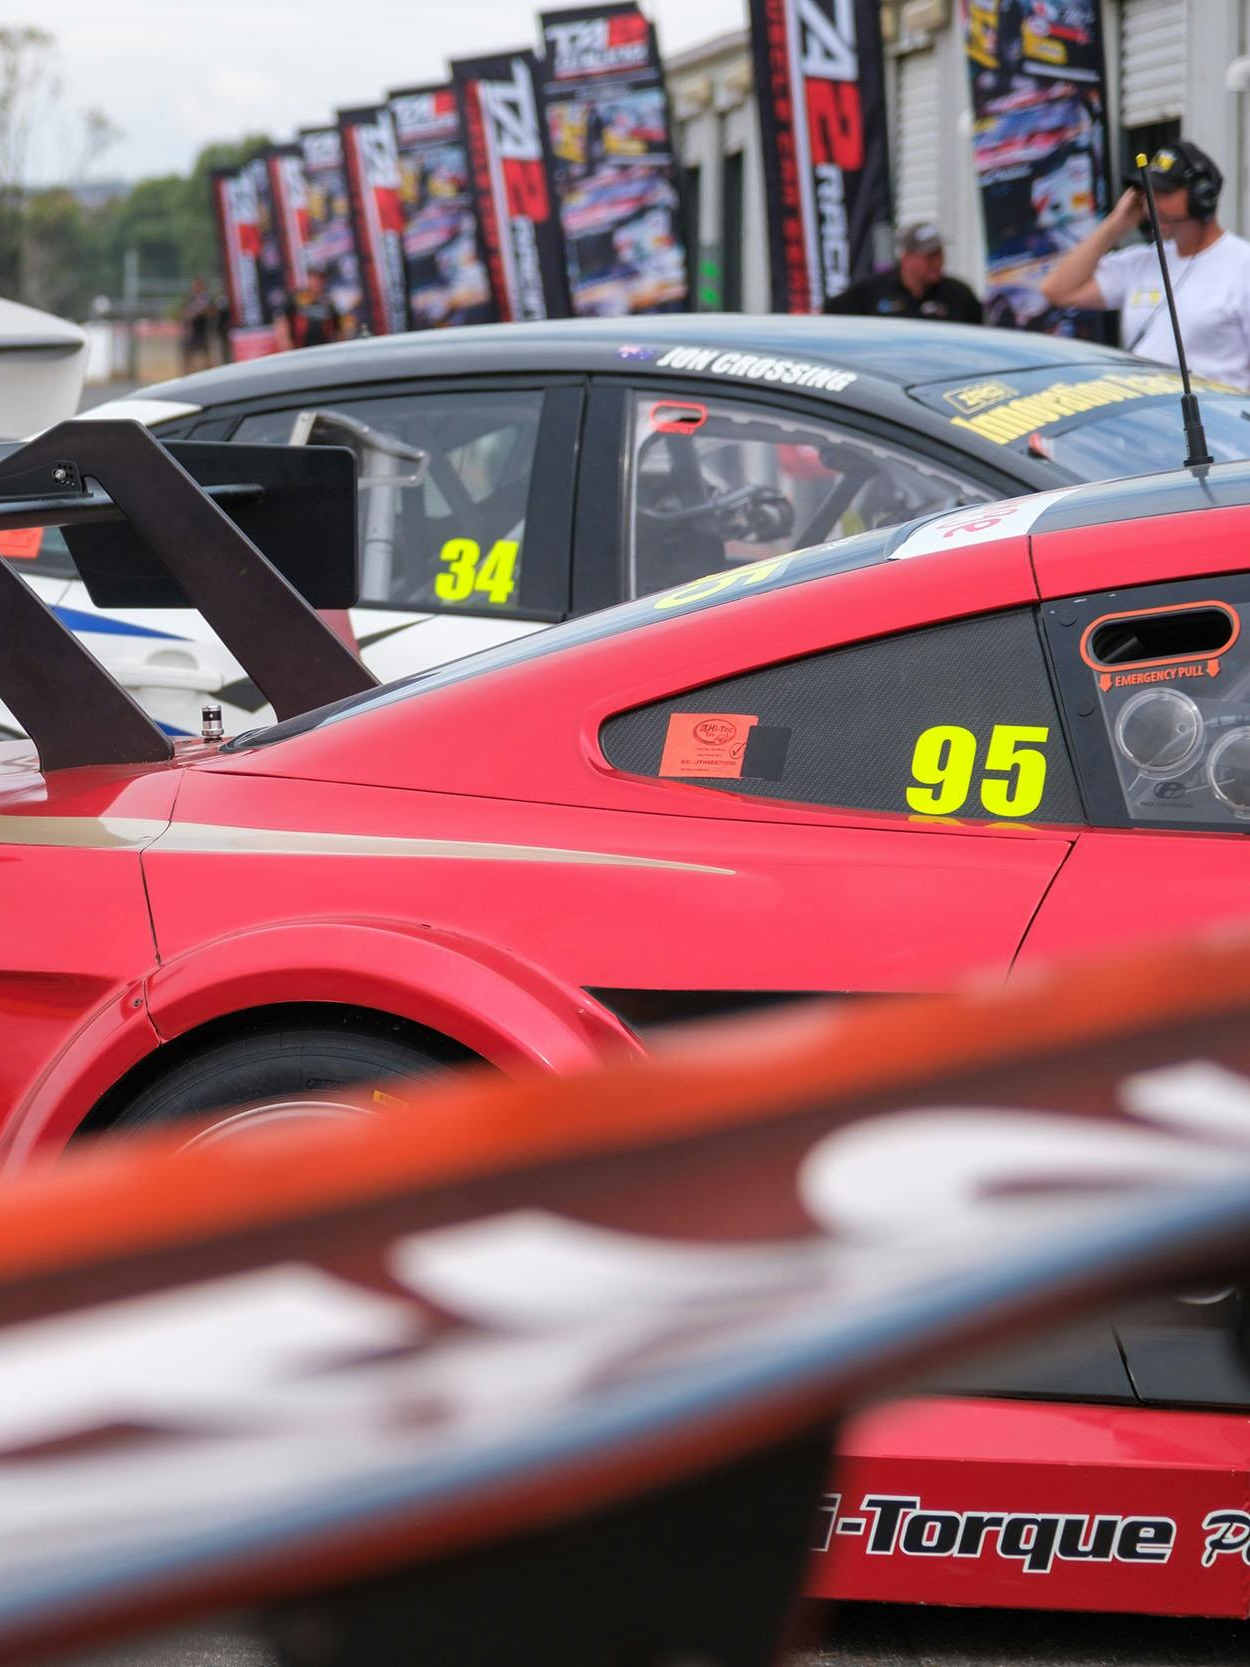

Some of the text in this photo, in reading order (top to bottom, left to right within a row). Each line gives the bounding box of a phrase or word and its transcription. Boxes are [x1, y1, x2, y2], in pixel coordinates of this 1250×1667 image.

[656, 346, 858, 392] JON CROSSING
[435, 538, 520, 604] 34
[1114, 665, 1204, 688] EMERGENCY PULL
[905, 725, 1050, 817] 95
[1200, 1509, 1250, 1568] P
